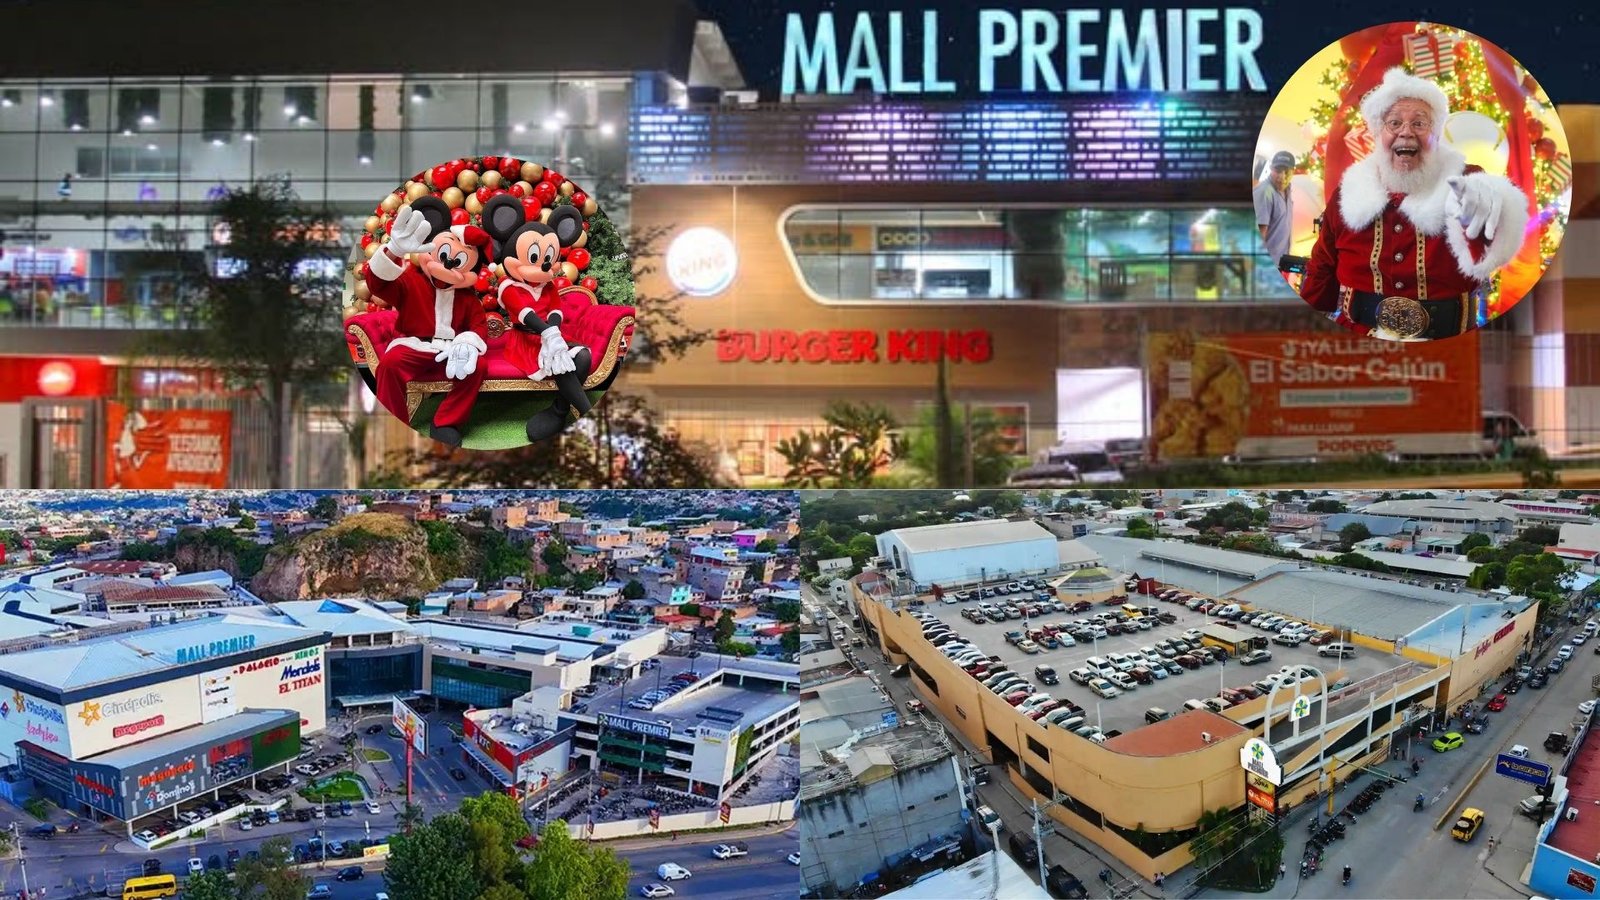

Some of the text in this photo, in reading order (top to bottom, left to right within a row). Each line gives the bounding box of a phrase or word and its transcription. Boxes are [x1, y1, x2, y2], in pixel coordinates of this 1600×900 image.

[780, 7, 1267, 96] MALL PREMIER
[716, 328, 993, 364] BURGER KING
[1250, 357, 1446, 384] El Sabor Cajún
[176, 634, 256, 665] MALL PREMIER
[279, 674, 322, 695] EL TITAN
[608, 716, 670, 738] MALL PREMIER
